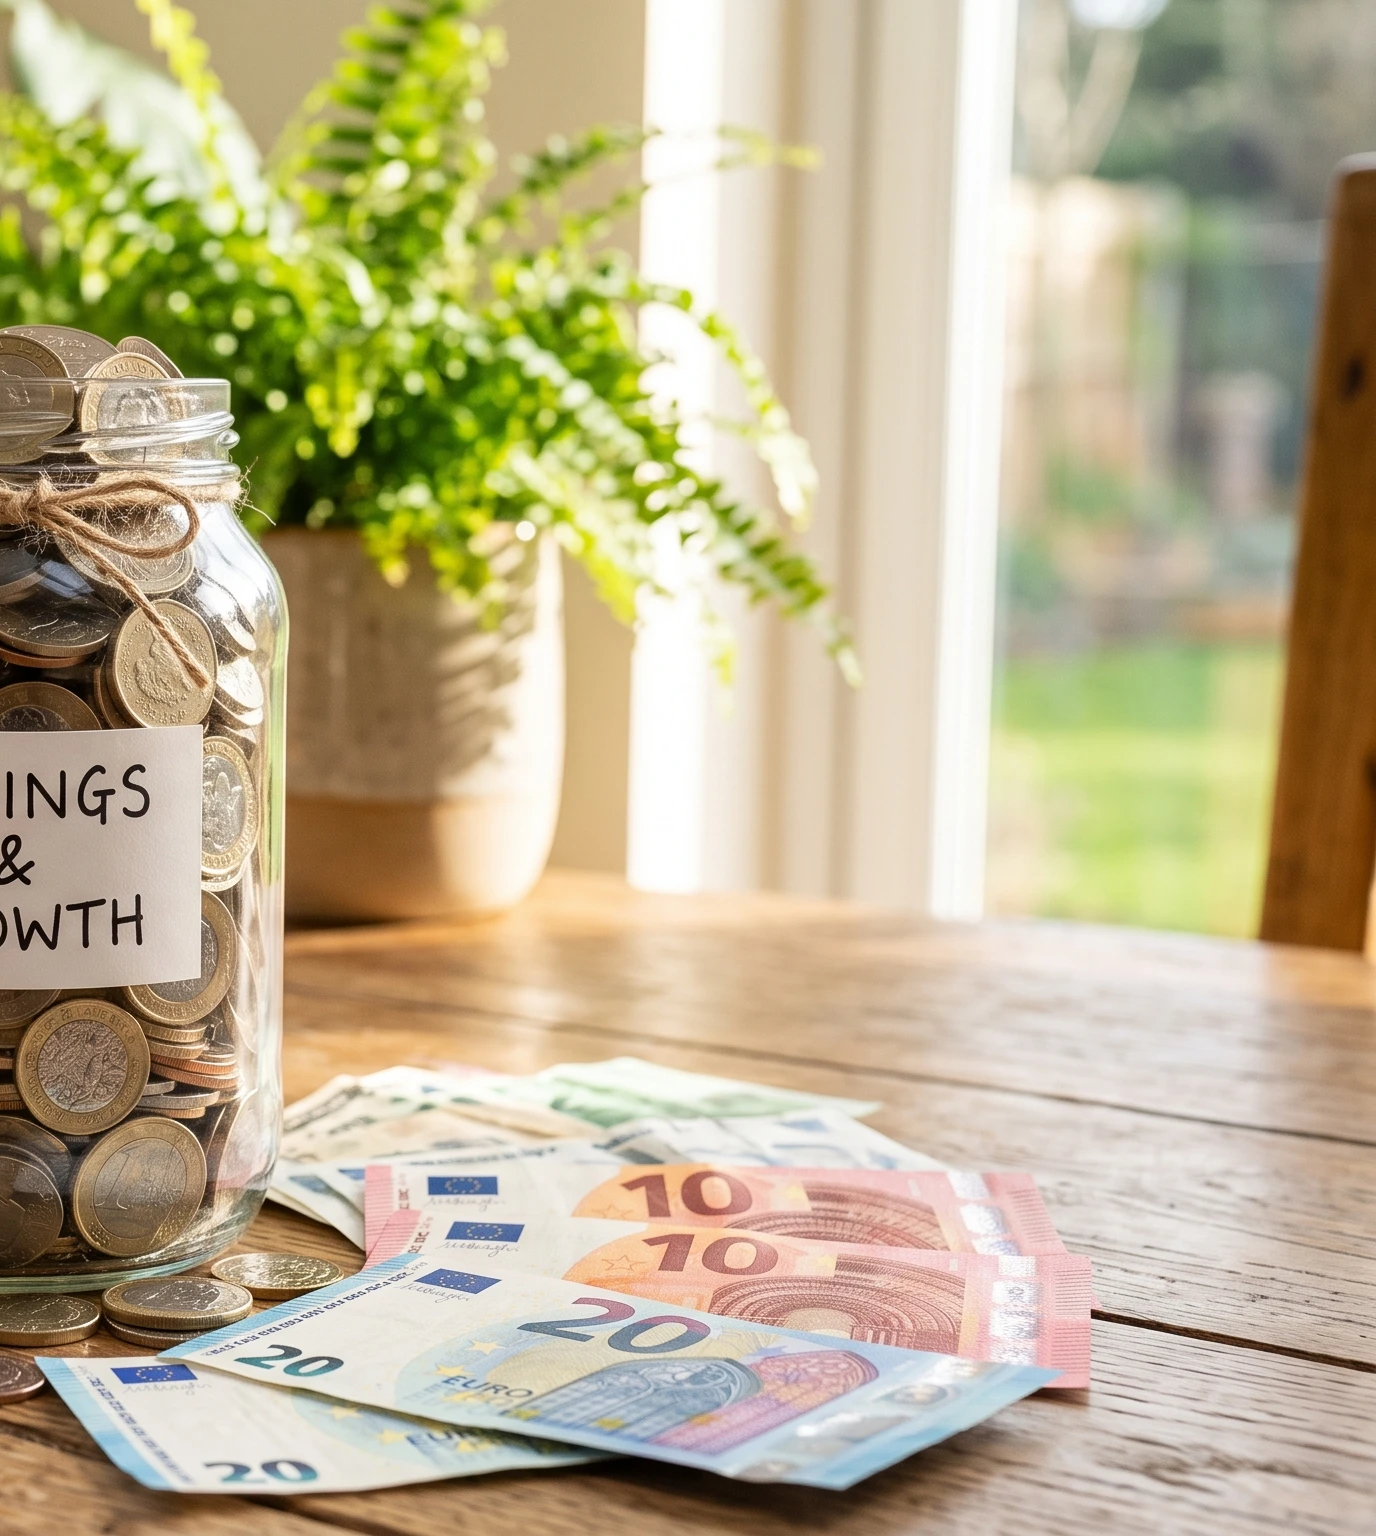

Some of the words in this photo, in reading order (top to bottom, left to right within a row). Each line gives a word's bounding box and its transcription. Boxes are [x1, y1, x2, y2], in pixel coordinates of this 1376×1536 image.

[621, 1171, 753, 1218] 10
[642, 1233, 779, 1276] 10
[517, 1297, 711, 1354] 20
[234, 1343, 345, 1378] 20
[442, 1375, 533, 1398] EURO
[204, 1459, 318, 1483] 20
